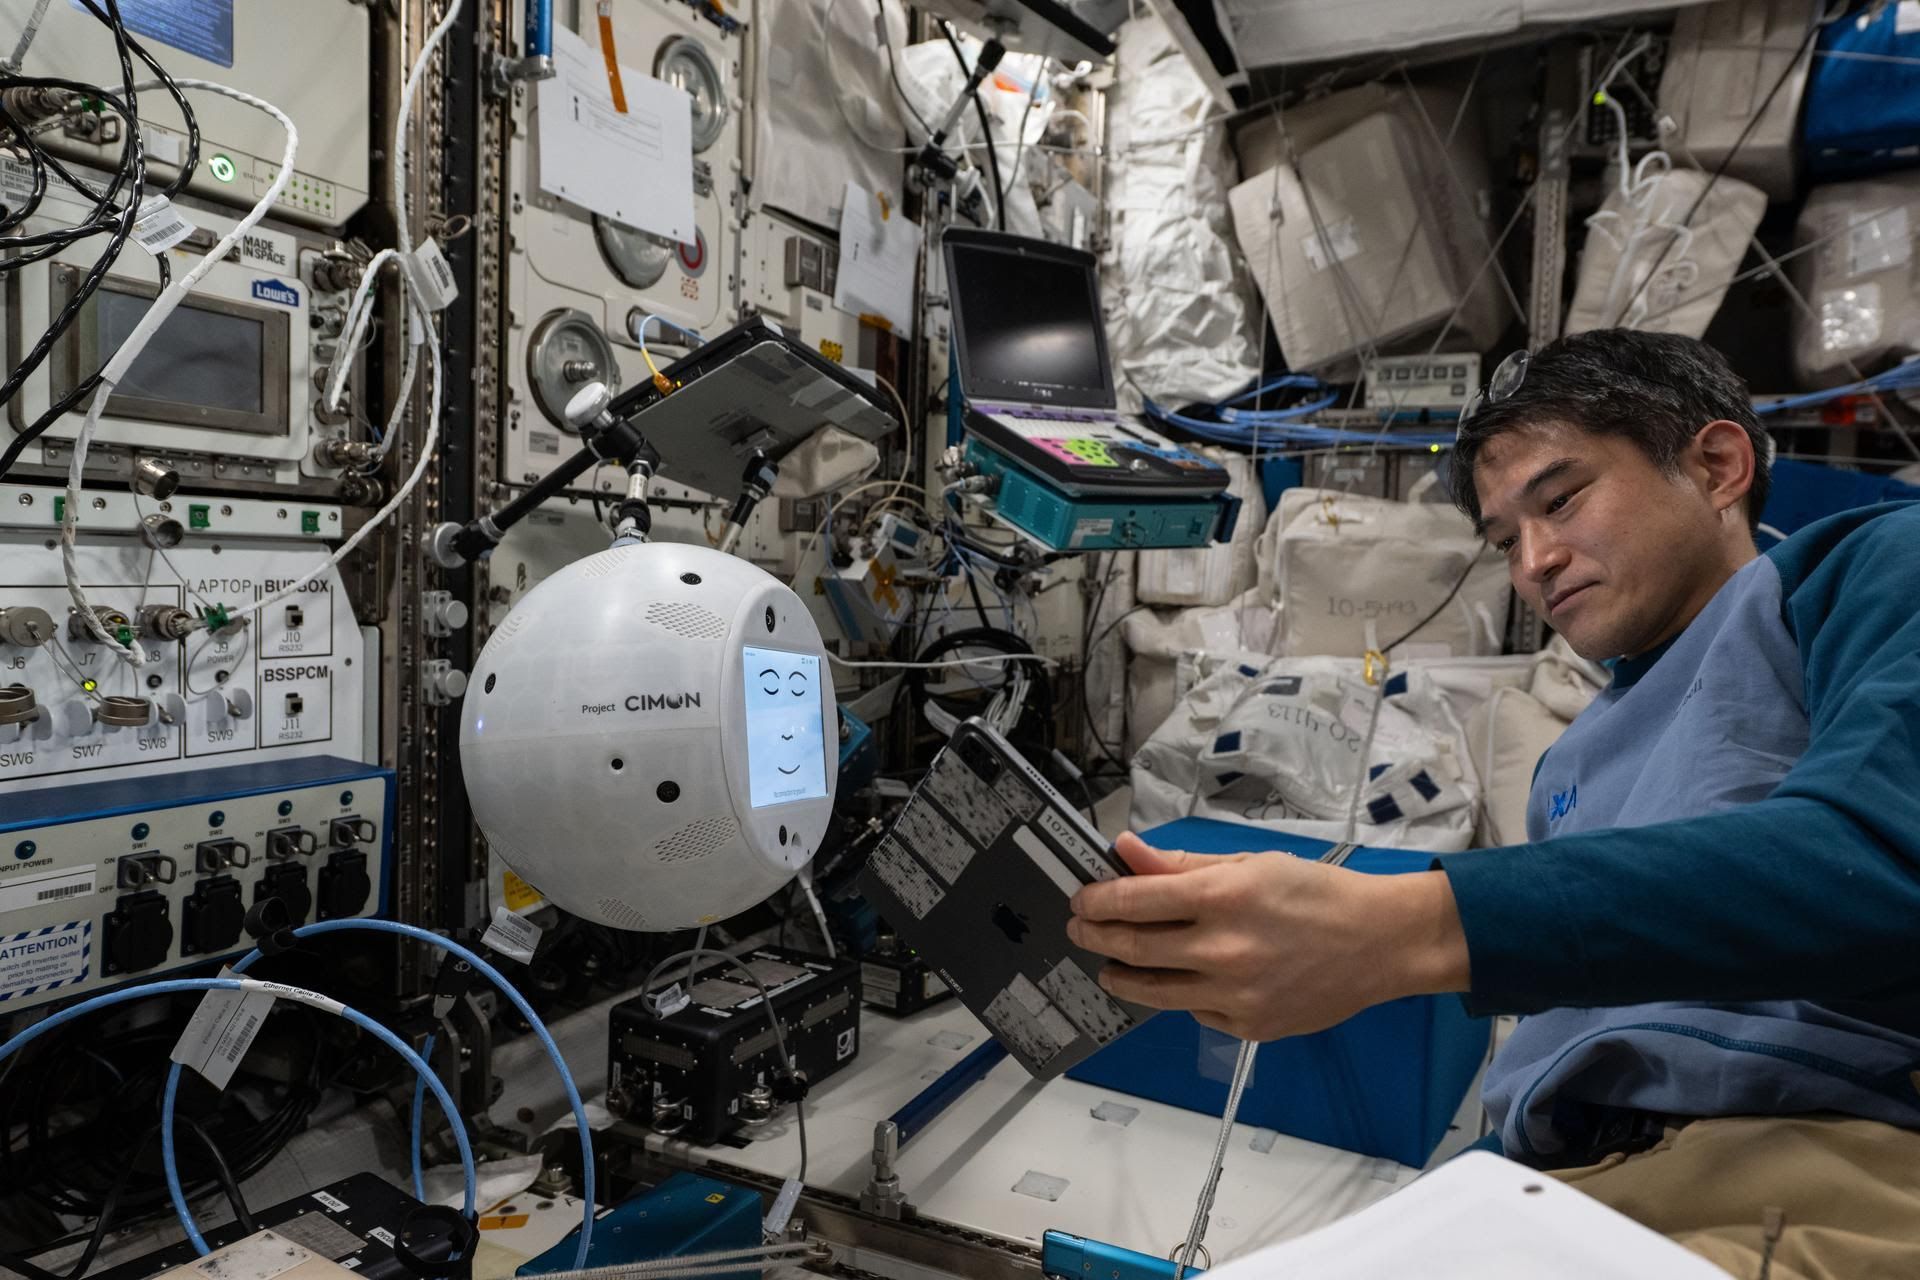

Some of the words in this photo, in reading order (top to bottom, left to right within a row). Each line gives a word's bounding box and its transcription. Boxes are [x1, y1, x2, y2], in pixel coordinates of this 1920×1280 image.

[243, 235, 273, 252] MADE
[243, 243, 254, 257] IN
[255, 248, 286, 266] SPACE
[256, 284, 295, 304] LOWE'S
[187, 579, 251, 593] LAPTOP
[282, 631, 300, 643] J10
[214, 643, 228, 654] J9
[7, 656, 25, 670] J6
[79, 653, 96, 666] J7
[207, 655, 234, 664] POWER
[264, 665, 328, 682] BSSPCM
[582, 703, 616, 716] Project
[624, 691, 701, 712] CIMON
[282, 719, 300, 730] J11
[207, 729, 234, 743] SW9
[139, 737, 168, 751] SW8
[72, 744, 103, 759] SW7
[0, 752, 34, 767] SW6
[132, 842, 147, 850] SW1
[1045, 814, 1077, 848] 1075
[1080, 845, 1113, 879] TAK
[23, 857, 53, 869] POWER
[104, 857, 116, 865] ON
[99, 885, 114, 893] OFF
[0, 934, 78, 960] ATTENTION
[263, 981, 293, 993] Ethernet
